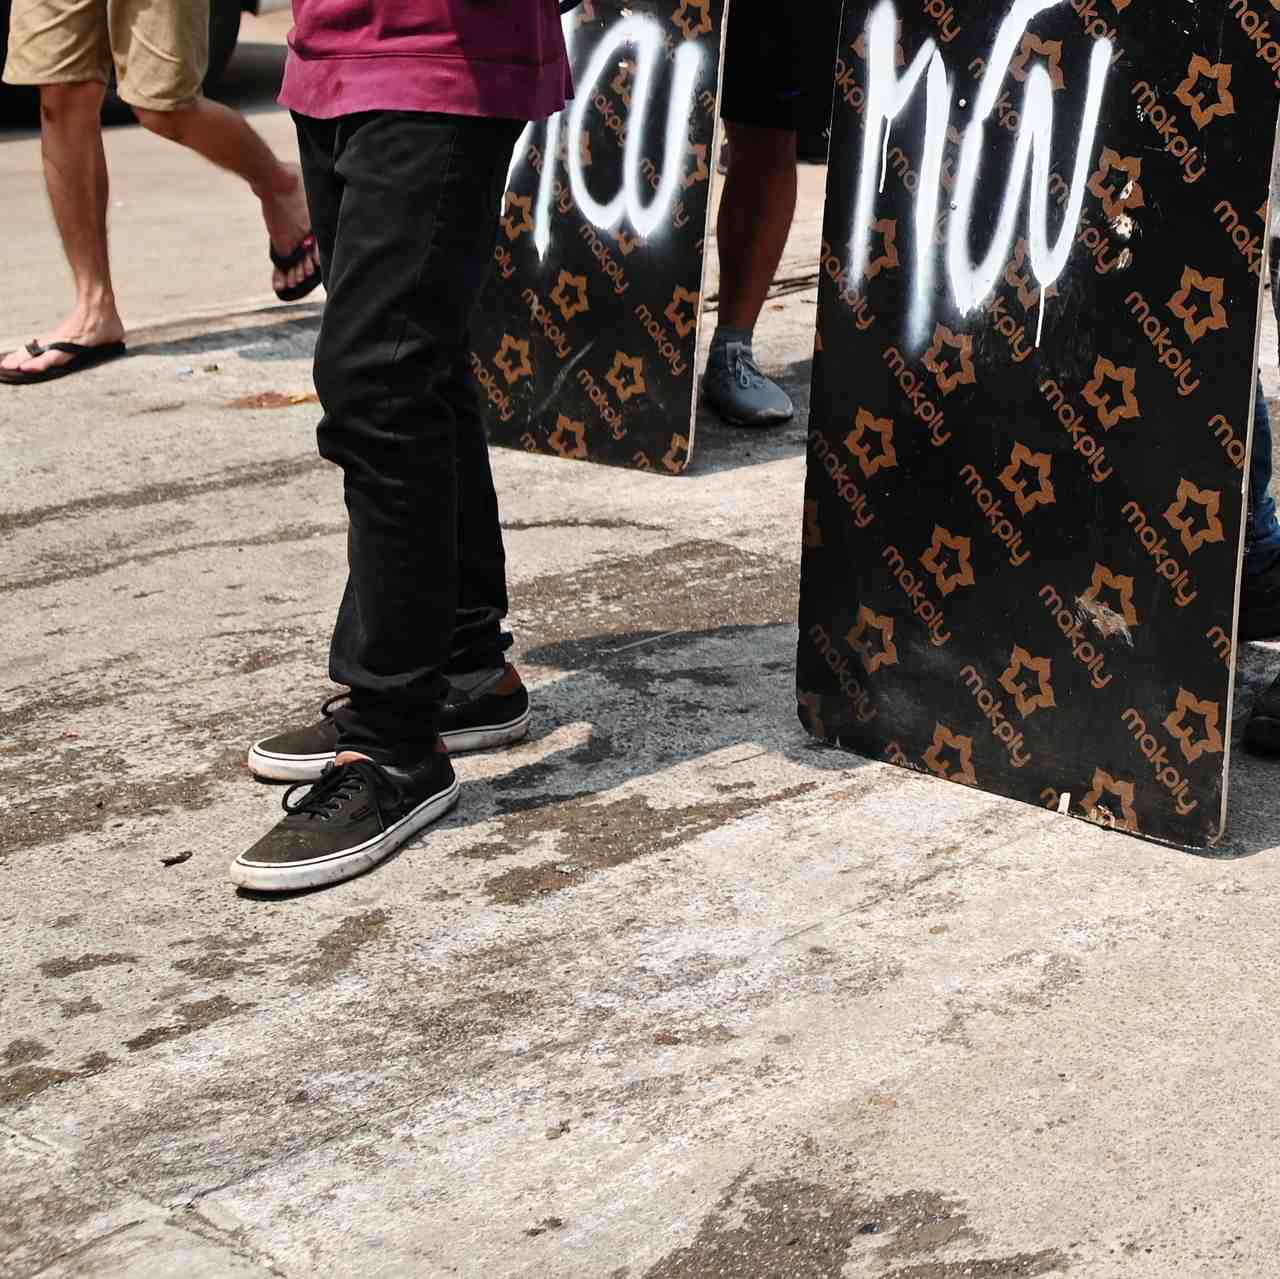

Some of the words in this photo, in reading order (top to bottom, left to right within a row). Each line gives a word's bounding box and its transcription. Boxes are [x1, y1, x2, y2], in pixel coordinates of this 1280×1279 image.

[1131, 79, 1207, 184] makply
[1213, 200, 1264, 277] mak
[987, 296, 1035, 362] kply
[1124, 291, 1201, 396] makply
[883, 346, 952, 447] makply
[1040, 378, 1114, 484] makply
[812, 430, 875, 528] makply
[959, 464, 1031, 567] makply
[881, 544, 952, 647] makply
[1121, 501, 1198, 607] makply
[811, 624, 878, 721] makply
[1038, 584, 1113, 689] makply
[959, 665, 1032, 768] makply
[1121, 708, 1198, 815] makply
